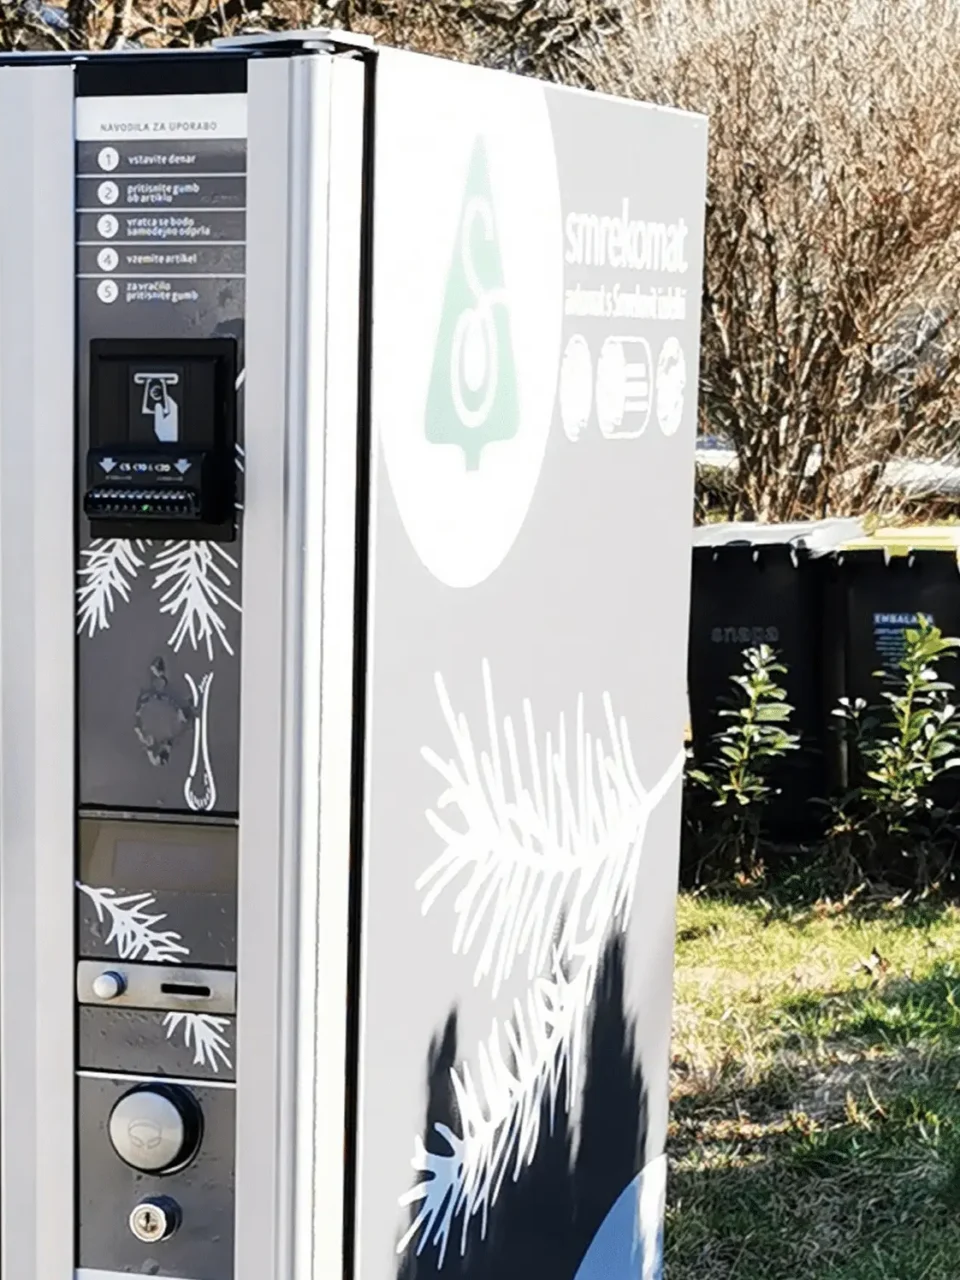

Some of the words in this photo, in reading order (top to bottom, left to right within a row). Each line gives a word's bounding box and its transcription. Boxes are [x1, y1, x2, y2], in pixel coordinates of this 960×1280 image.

[100, 122, 150, 132] NAVODILA
[153, 122, 166, 132] ZA
[169, 121, 218, 132] UPORABO
[128, 154, 167, 165] vstavite
[168, 153, 197, 165] denar
[127, 182, 172, 196] pritisnite
[127, 194, 139, 204] ob
[159, 218, 168, 227] se
[170, 217, 195, 227] bodo
[565, 198, 689, 274] smrekomat
[126, 253, 165, 264] vzemite
[165, 253, 198, 264] artikel
[126, 282, 138, 291] za
[874, 613, 933, 625] EMBALAA
